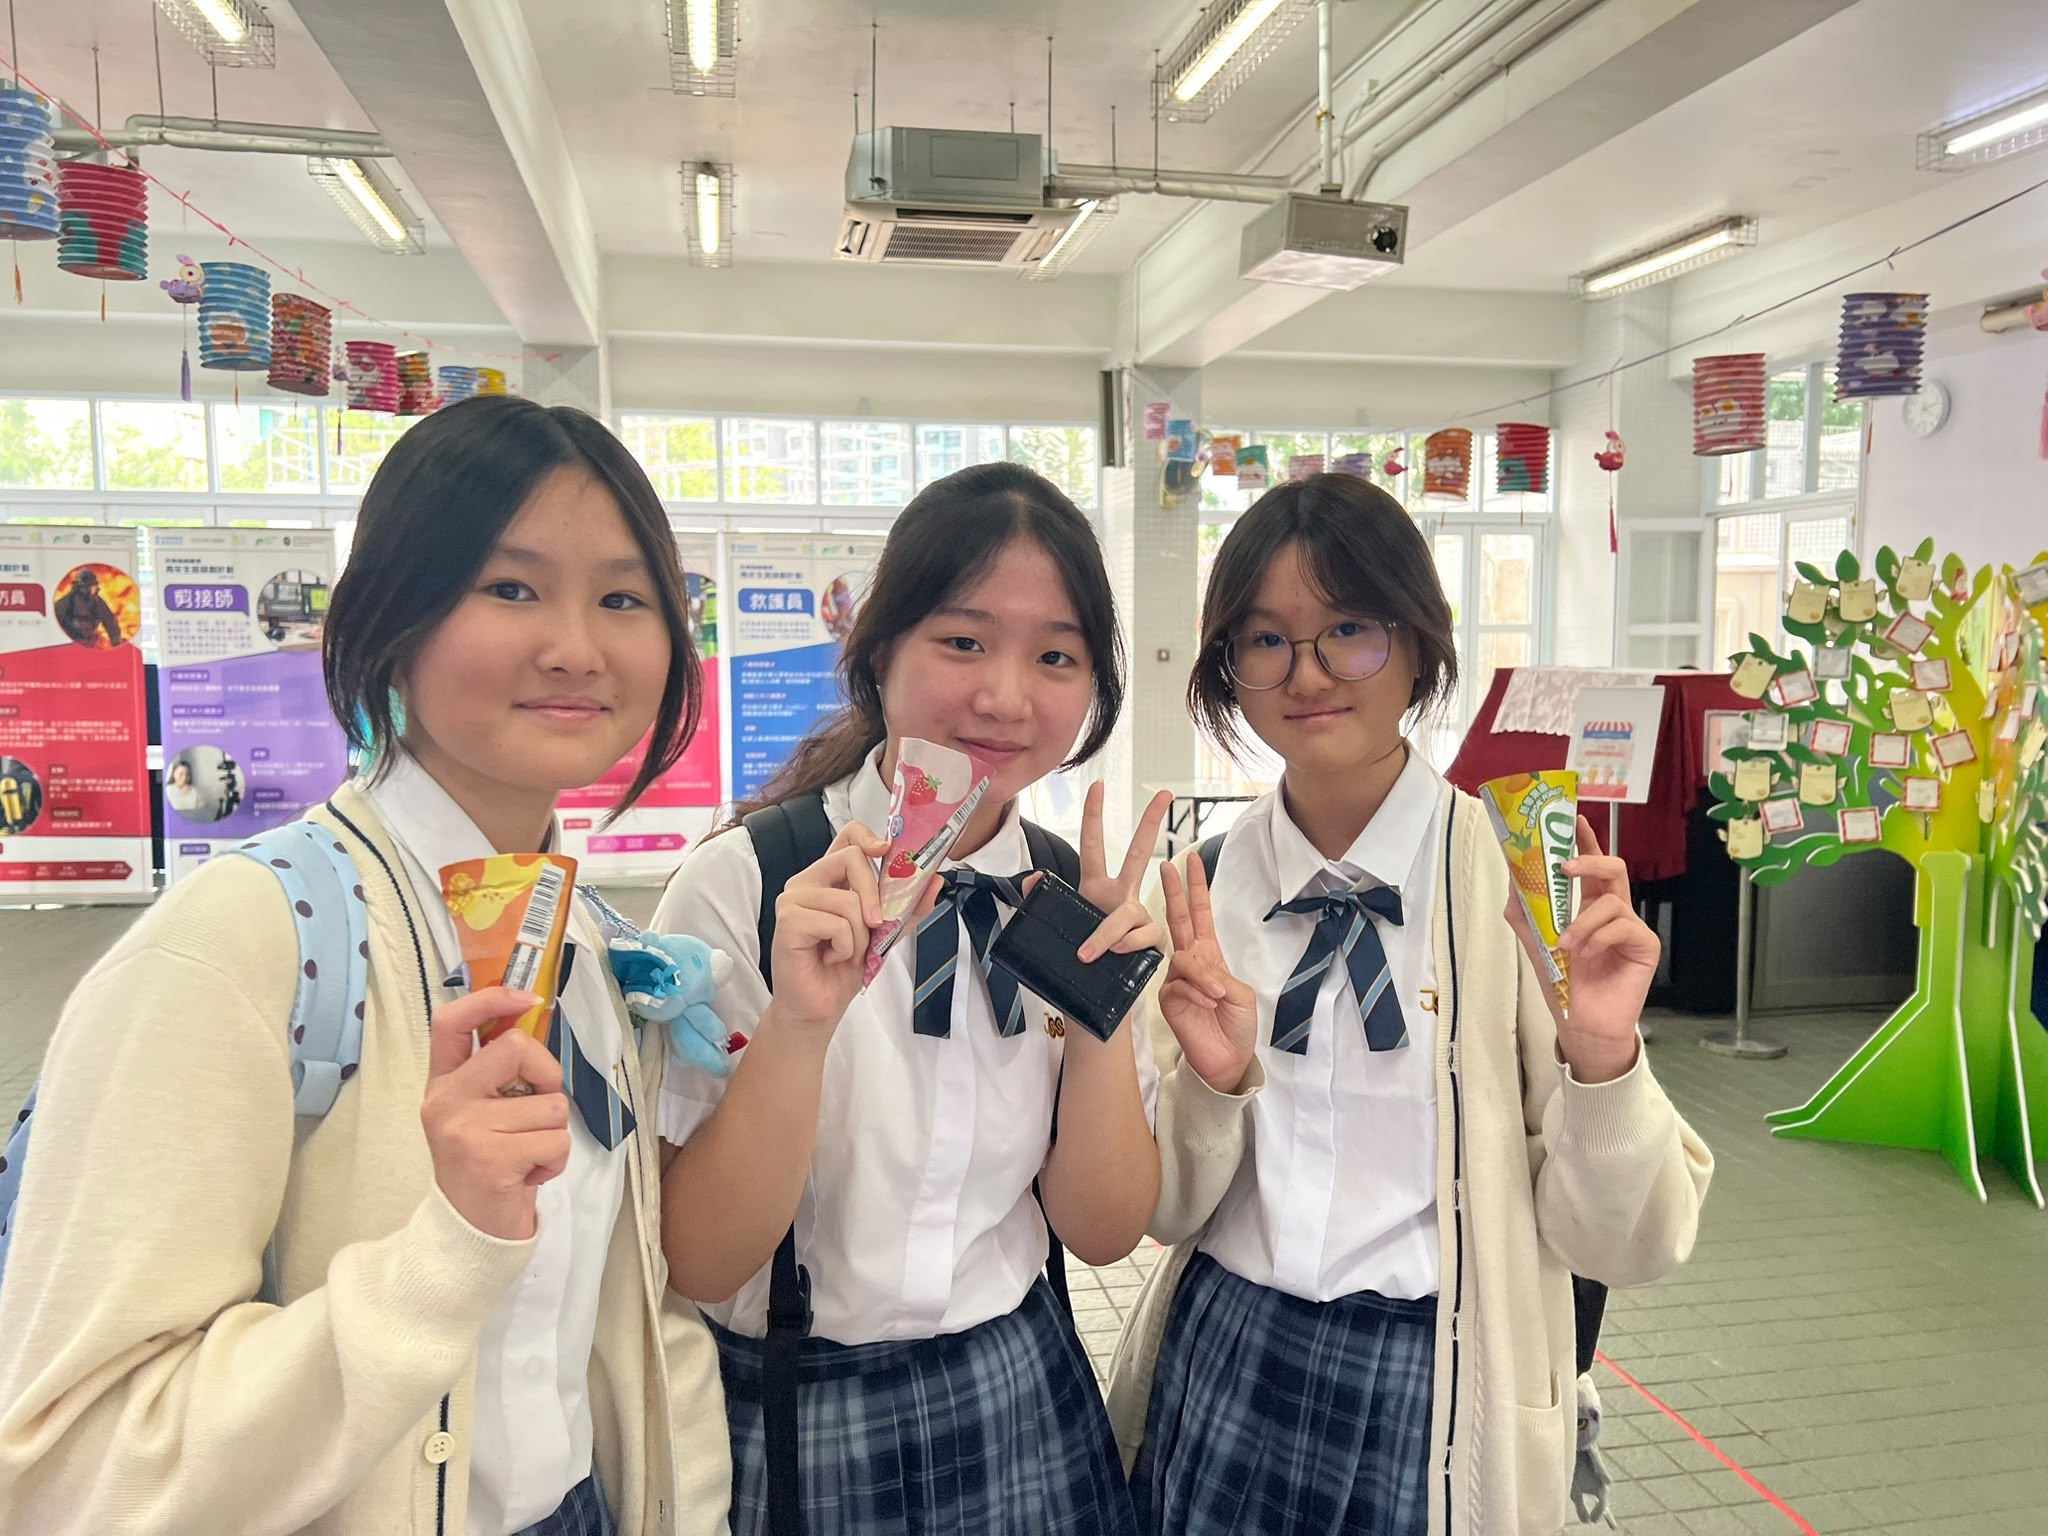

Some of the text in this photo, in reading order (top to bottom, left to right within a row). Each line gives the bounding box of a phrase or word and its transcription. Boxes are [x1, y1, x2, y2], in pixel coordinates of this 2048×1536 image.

[173, 588, 234, 609] 剪接師
[749, 592, 804, 611] 救護員
